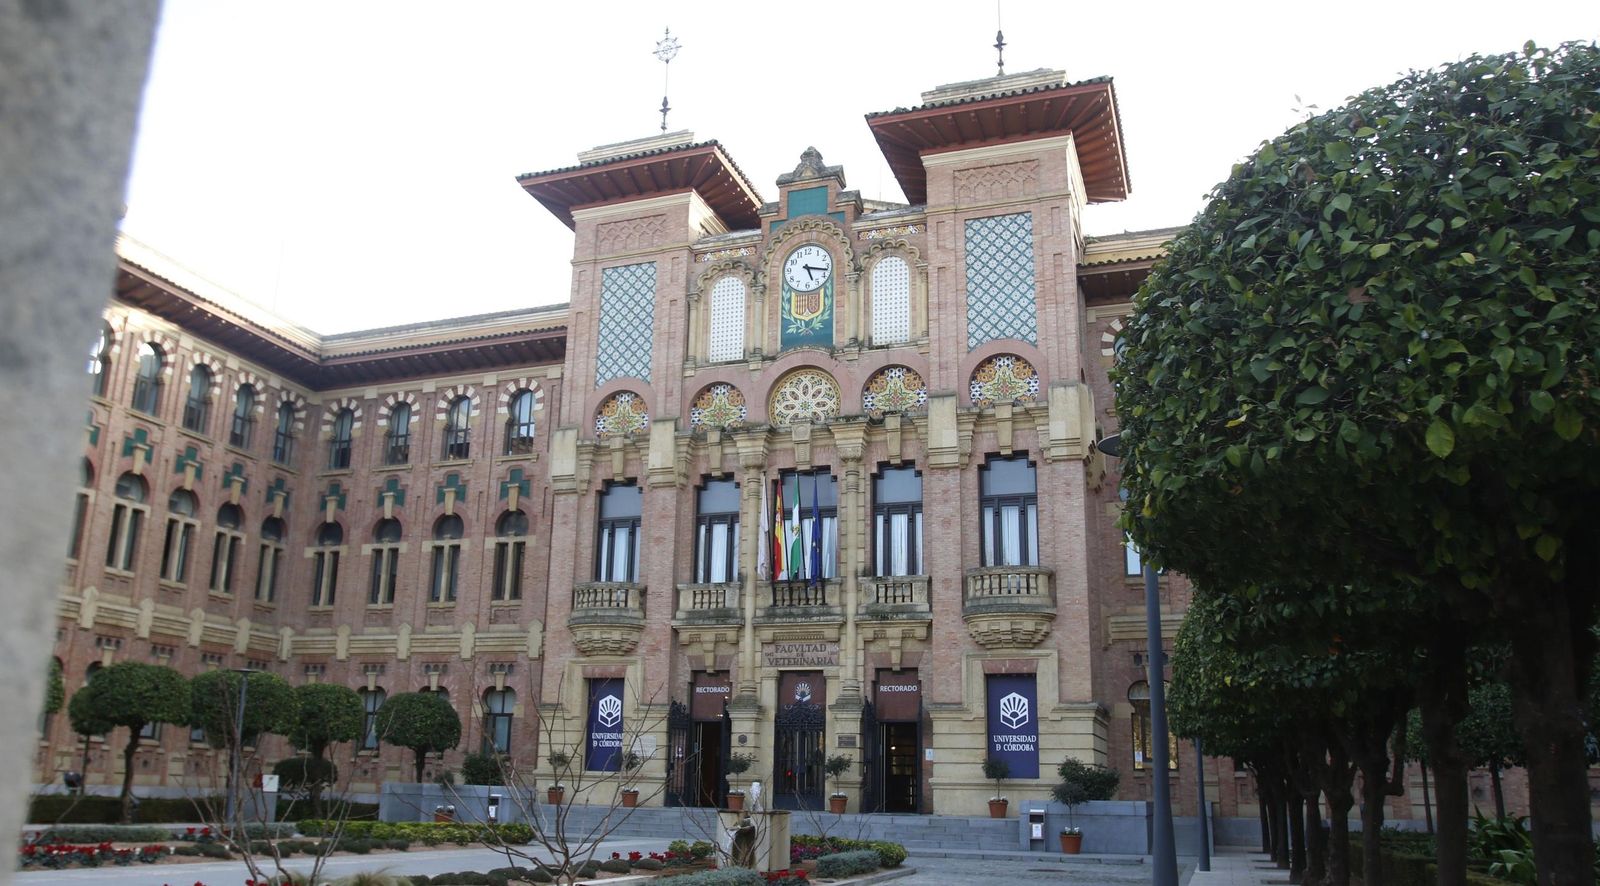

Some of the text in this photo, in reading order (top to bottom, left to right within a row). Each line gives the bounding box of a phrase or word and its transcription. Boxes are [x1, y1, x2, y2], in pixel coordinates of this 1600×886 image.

[804, 247, 812, 255] 12
[804, 281, 810, 289] 6
[814, 278, 820, 286] 5
[768, 657, 834, 665] VETERINARIA
[1003, 742, 1034, 751] CÓRDOBA
